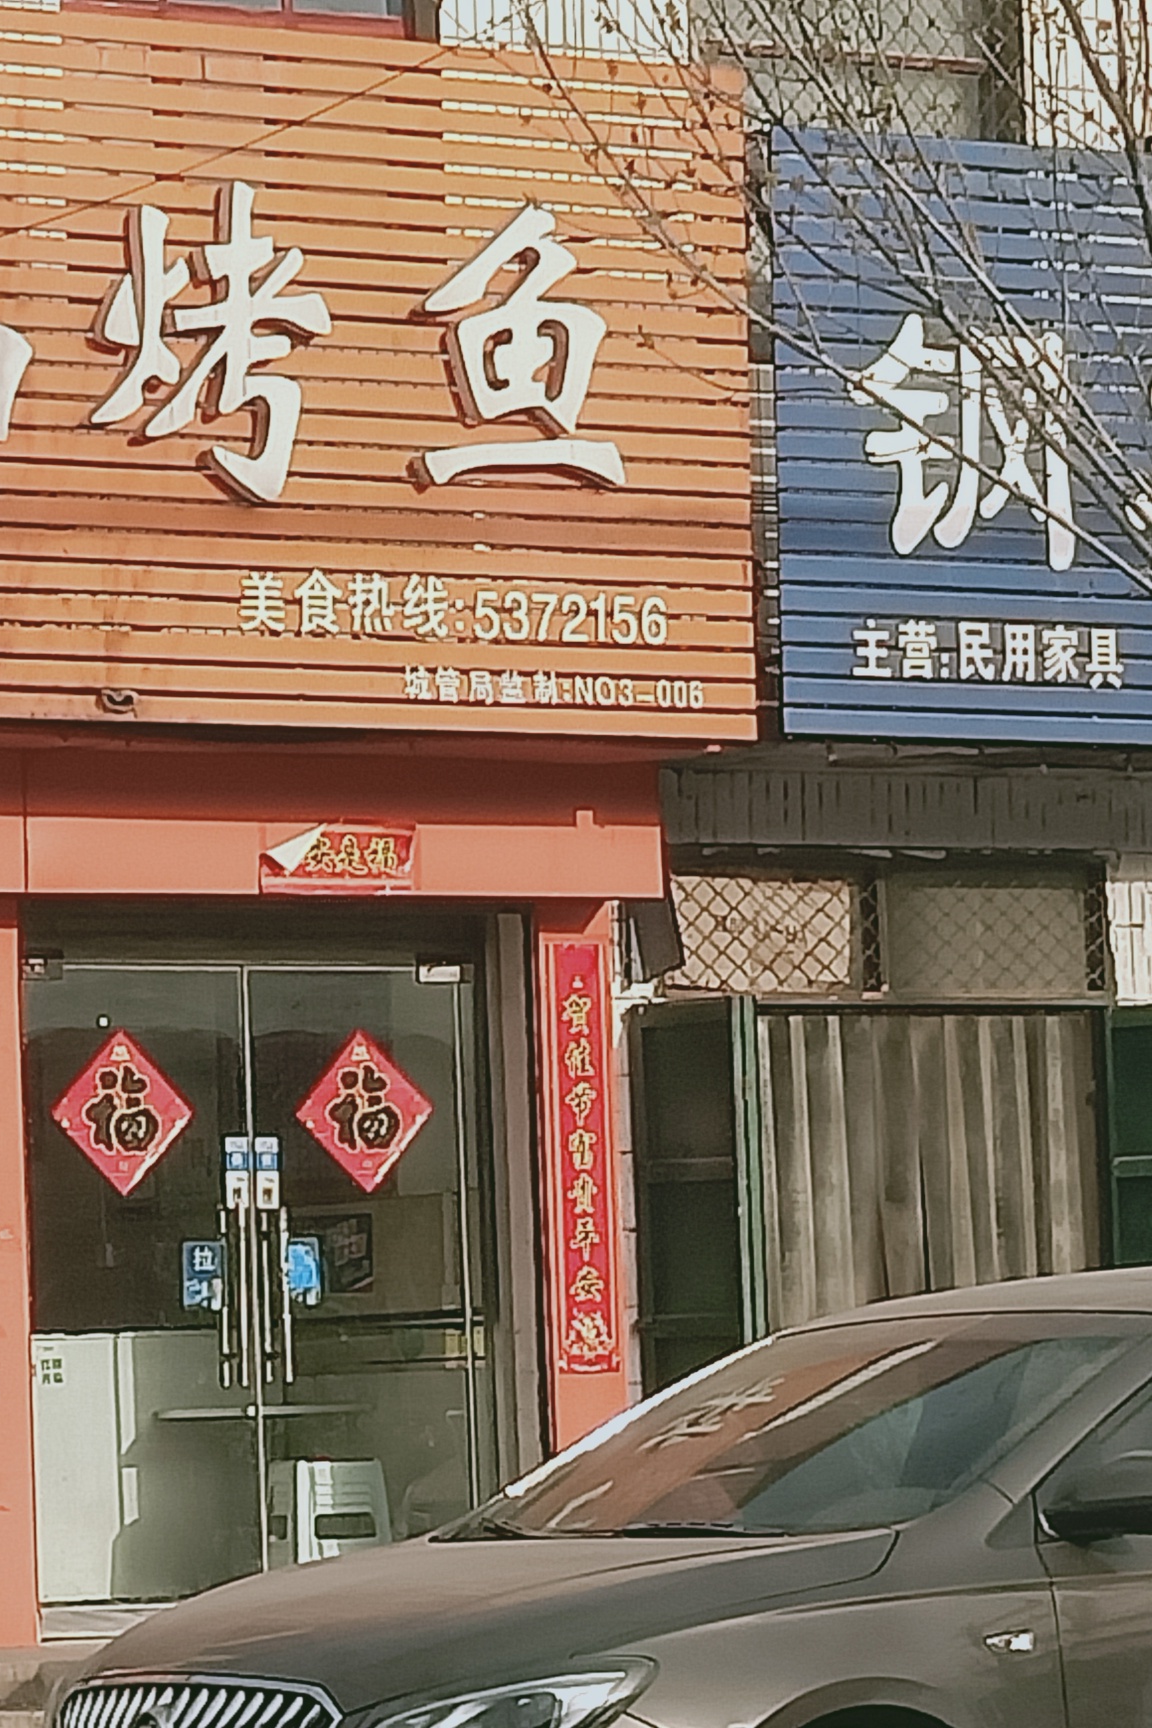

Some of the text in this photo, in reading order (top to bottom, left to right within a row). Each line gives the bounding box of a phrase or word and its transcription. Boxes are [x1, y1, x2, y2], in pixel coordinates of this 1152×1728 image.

[849, 313, 1152, 571] 钢
[239, 569, 670, 646] 美食热线:5372156
[852, 619, 1124, 690] 主营:民用家具
[81, 1063, 162, 1156] 福
[324, 1061, 402, 1154] 福
